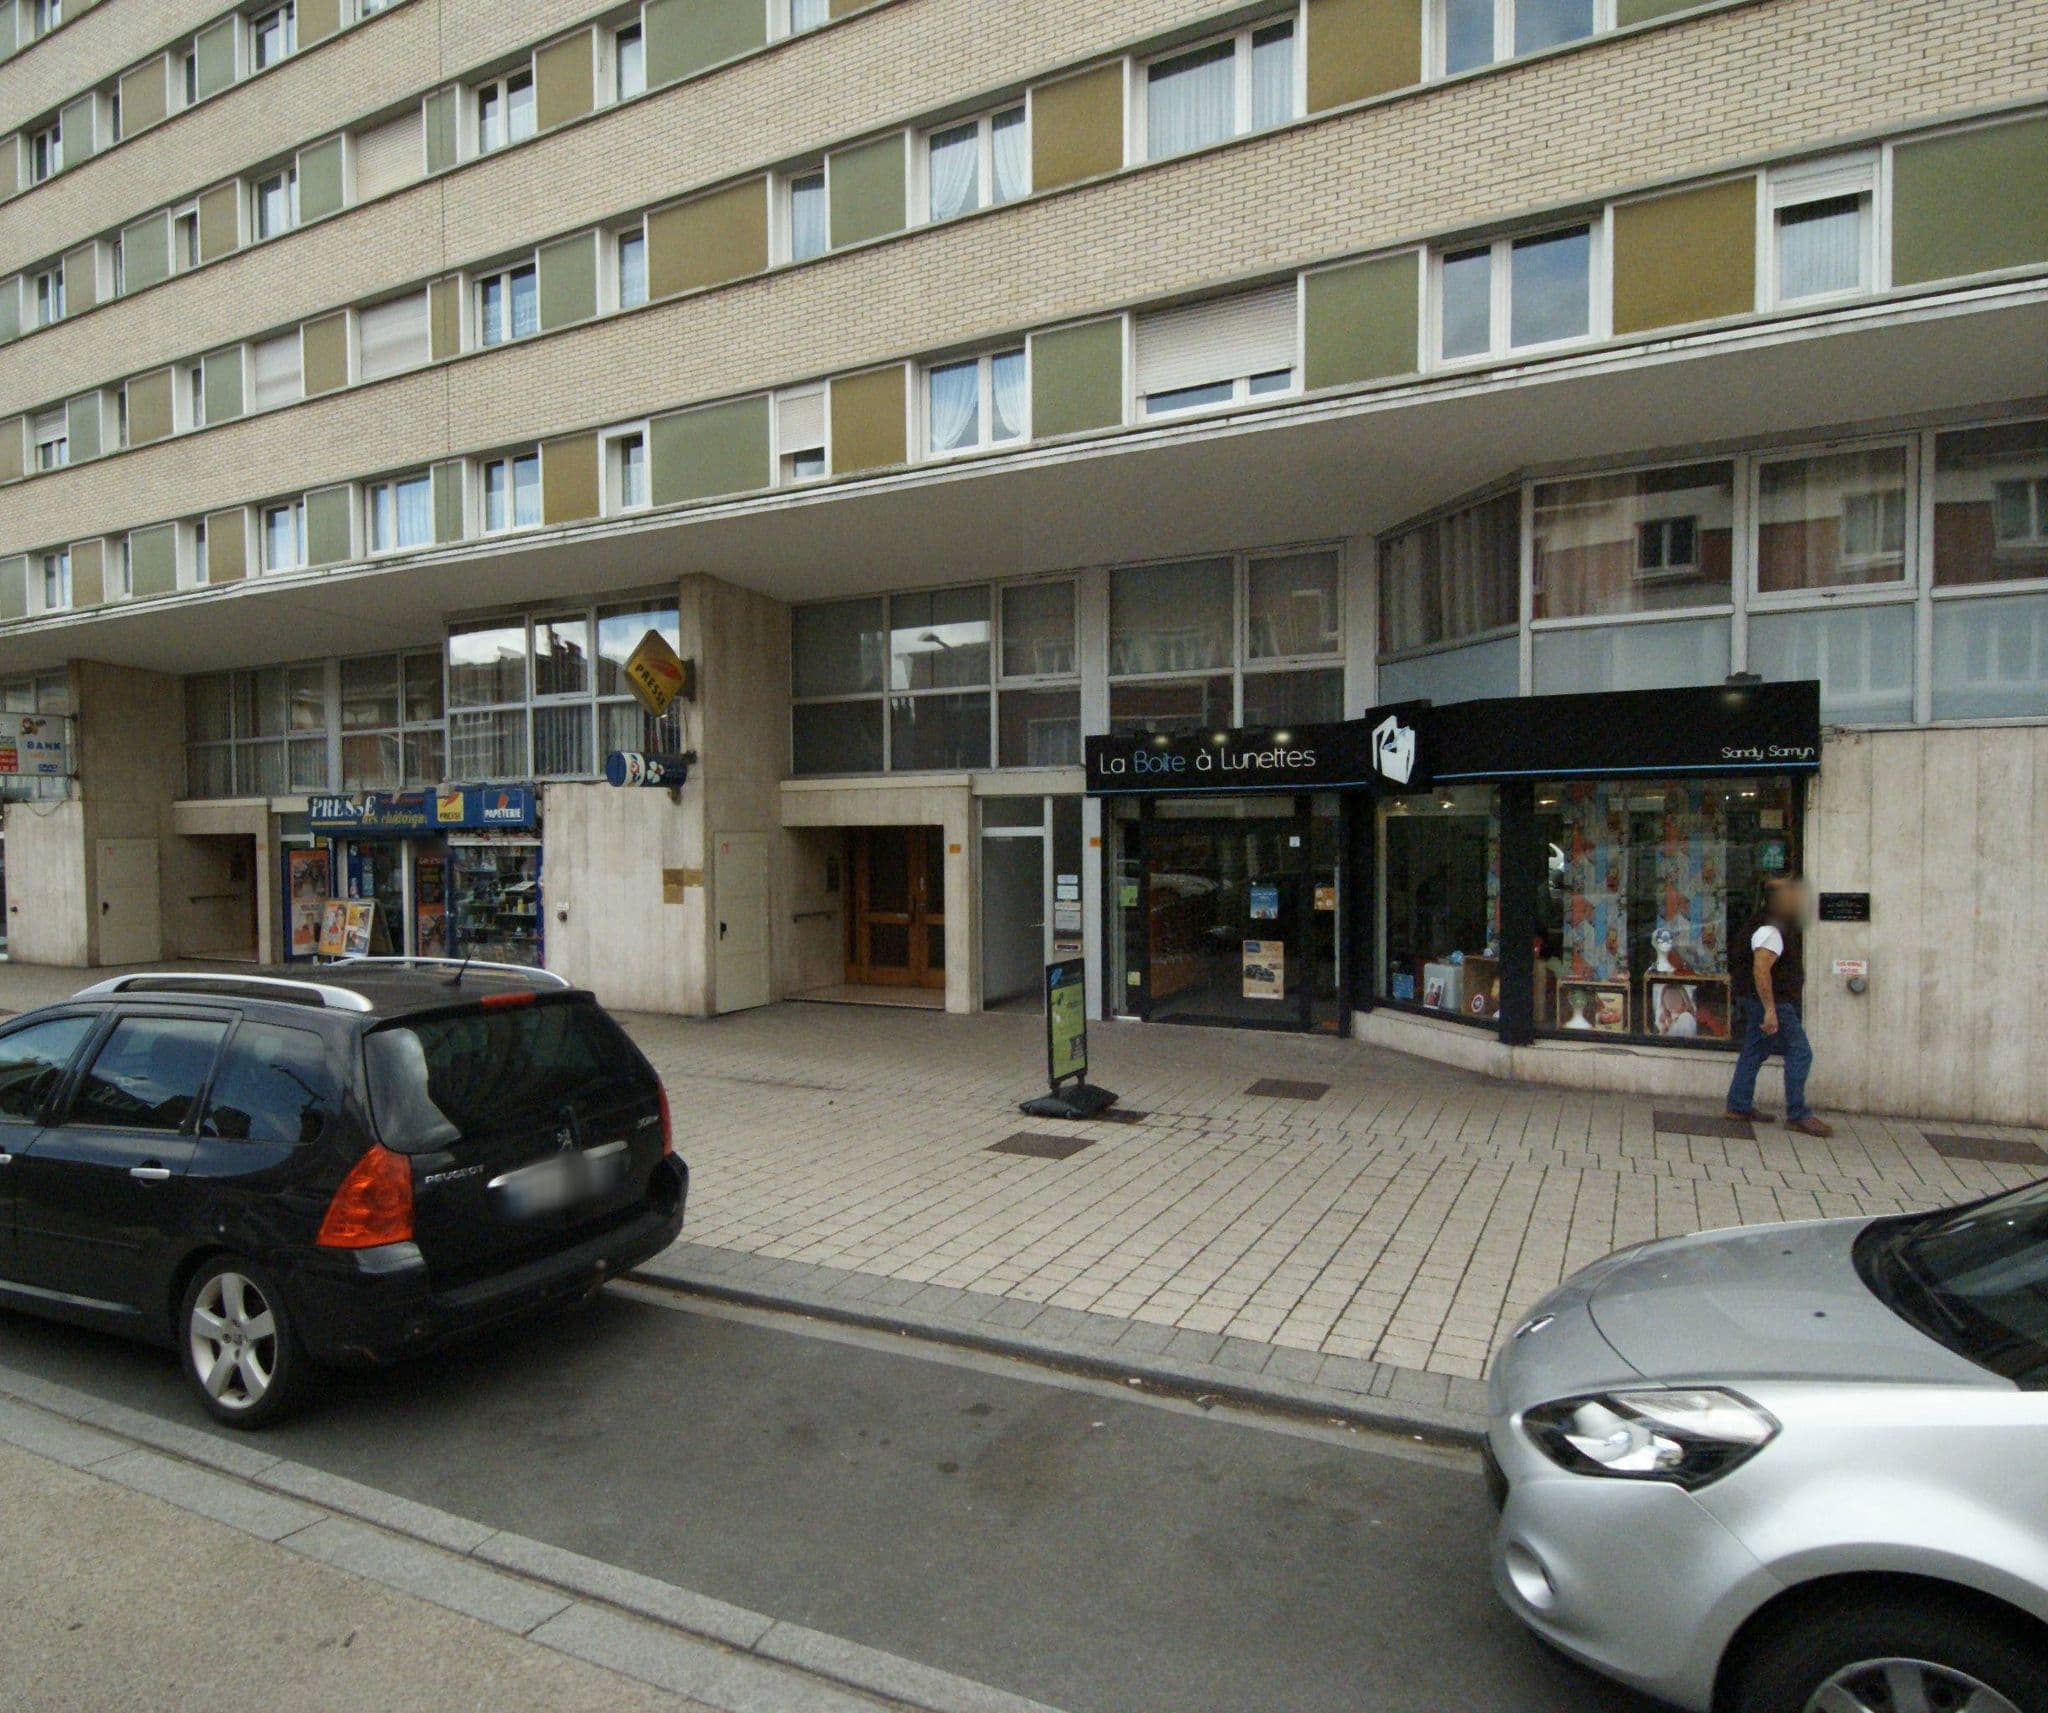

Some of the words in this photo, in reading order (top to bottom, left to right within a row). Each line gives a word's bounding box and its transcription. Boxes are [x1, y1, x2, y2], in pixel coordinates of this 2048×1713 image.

[1099, 753, 1126, 775] La
[1196, 748, 1212, 771] à
[1221, 747, 1317, 771] Lunettes
[1721, 746, 1763, 761] Sandy
[484, 808, 521, 819] PAPETERIE
[424, 1164, 485, 1185] PEUGEOT
